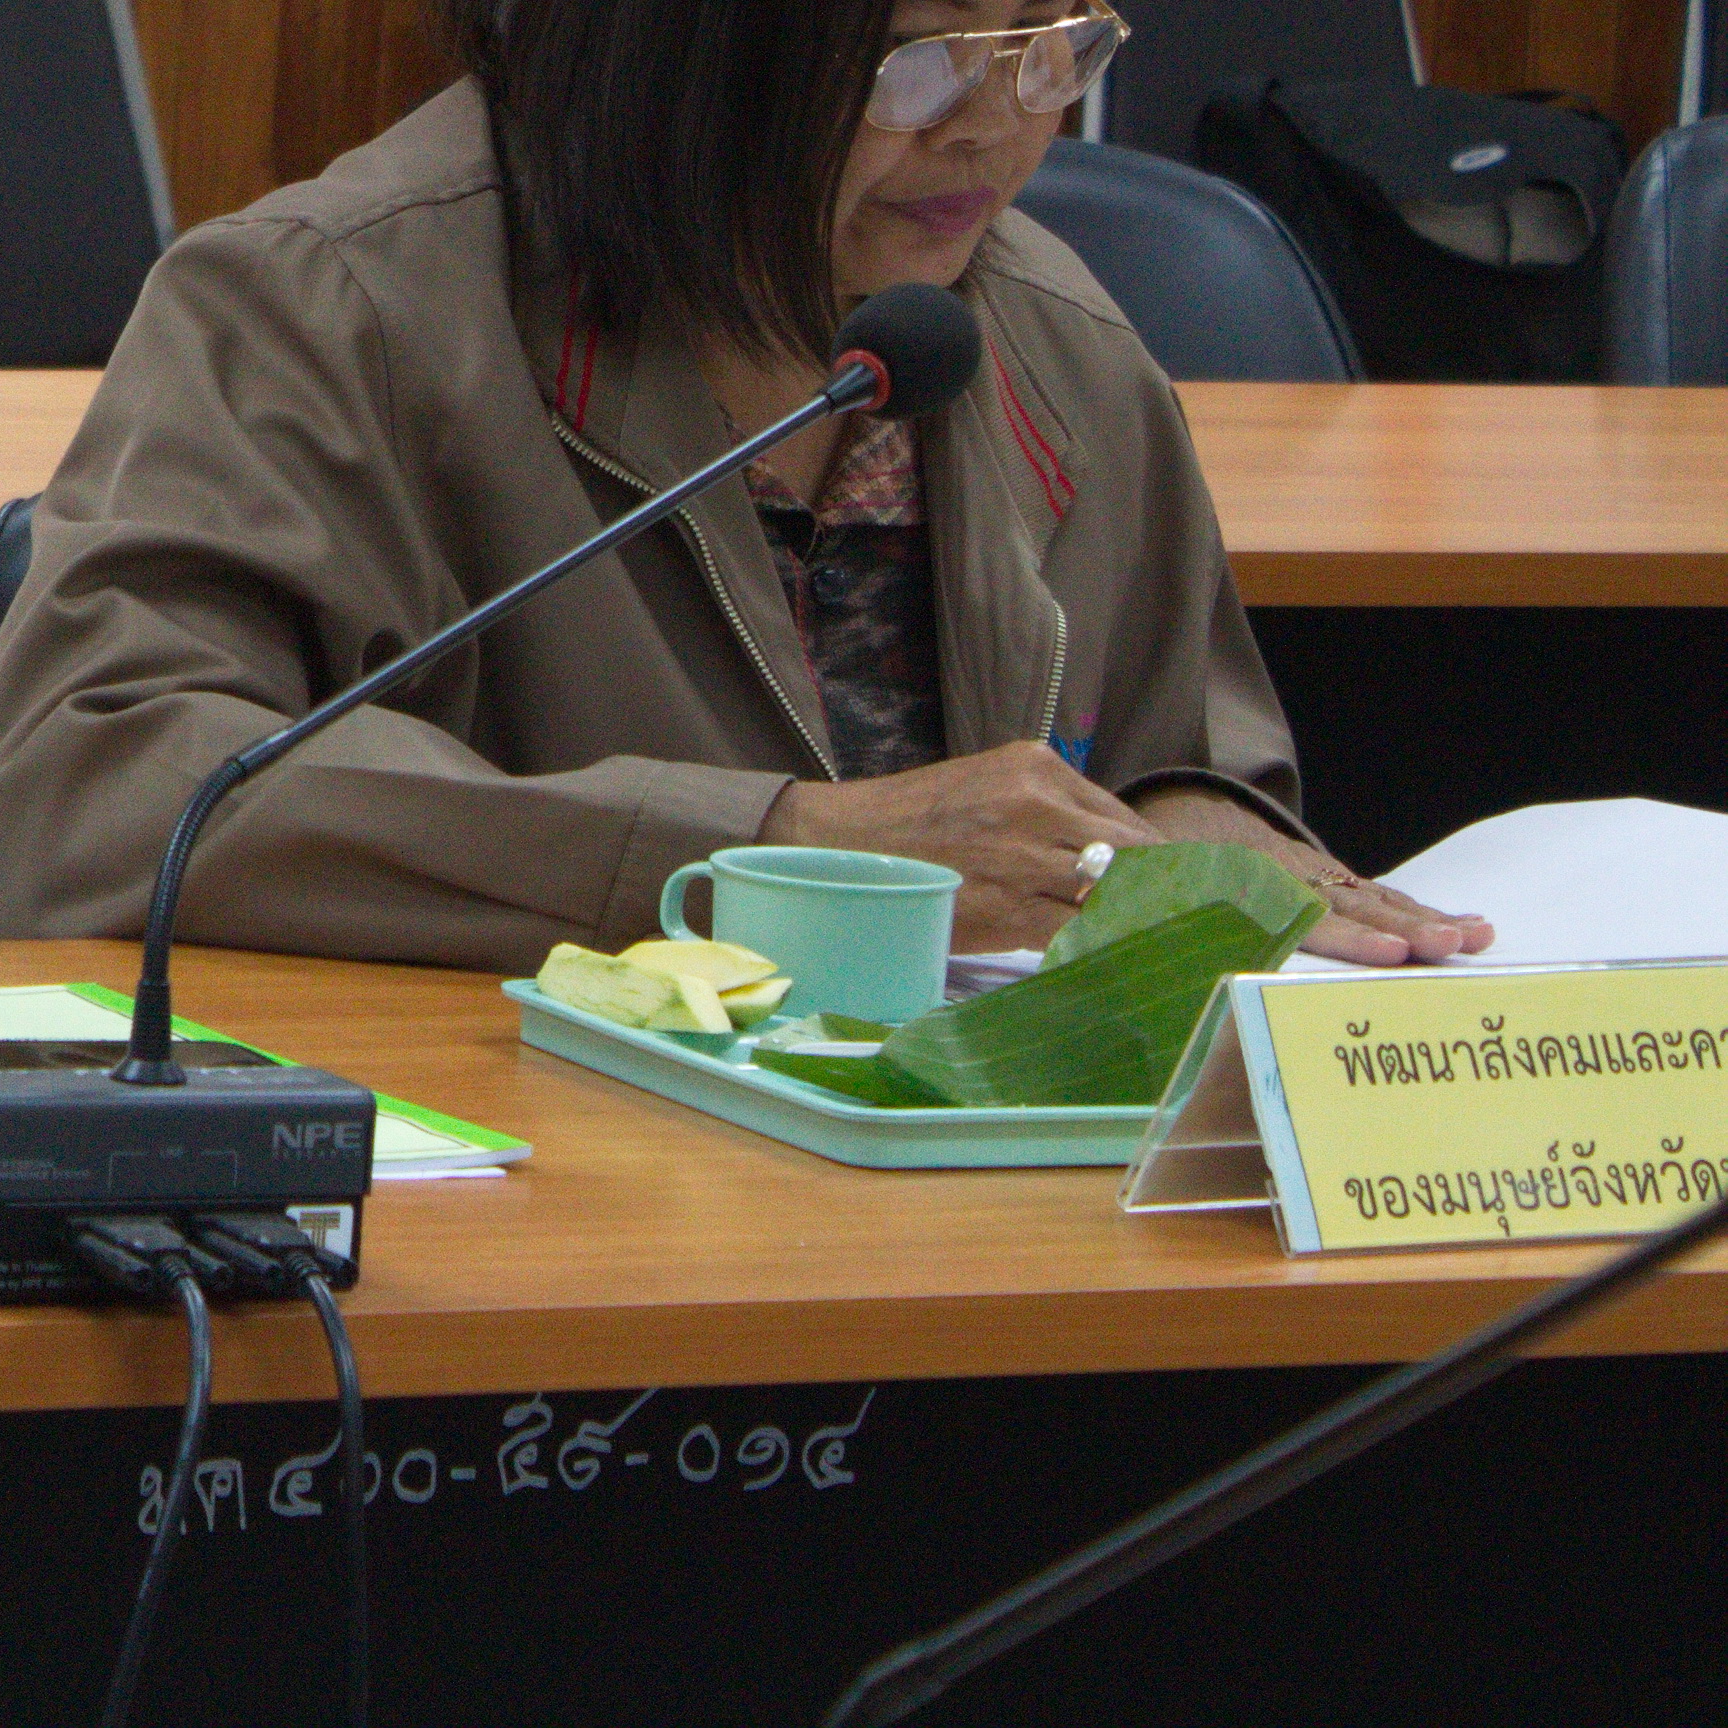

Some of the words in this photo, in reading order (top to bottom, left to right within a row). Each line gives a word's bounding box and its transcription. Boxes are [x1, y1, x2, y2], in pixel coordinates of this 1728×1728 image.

[1334, 1015, 1728, 1087] พัฒนาสังคมและค
[272, 1121, 364, 1150] NPE
[1344, 1136, 1728, 1236] ของมนุษย์จังหวัด
